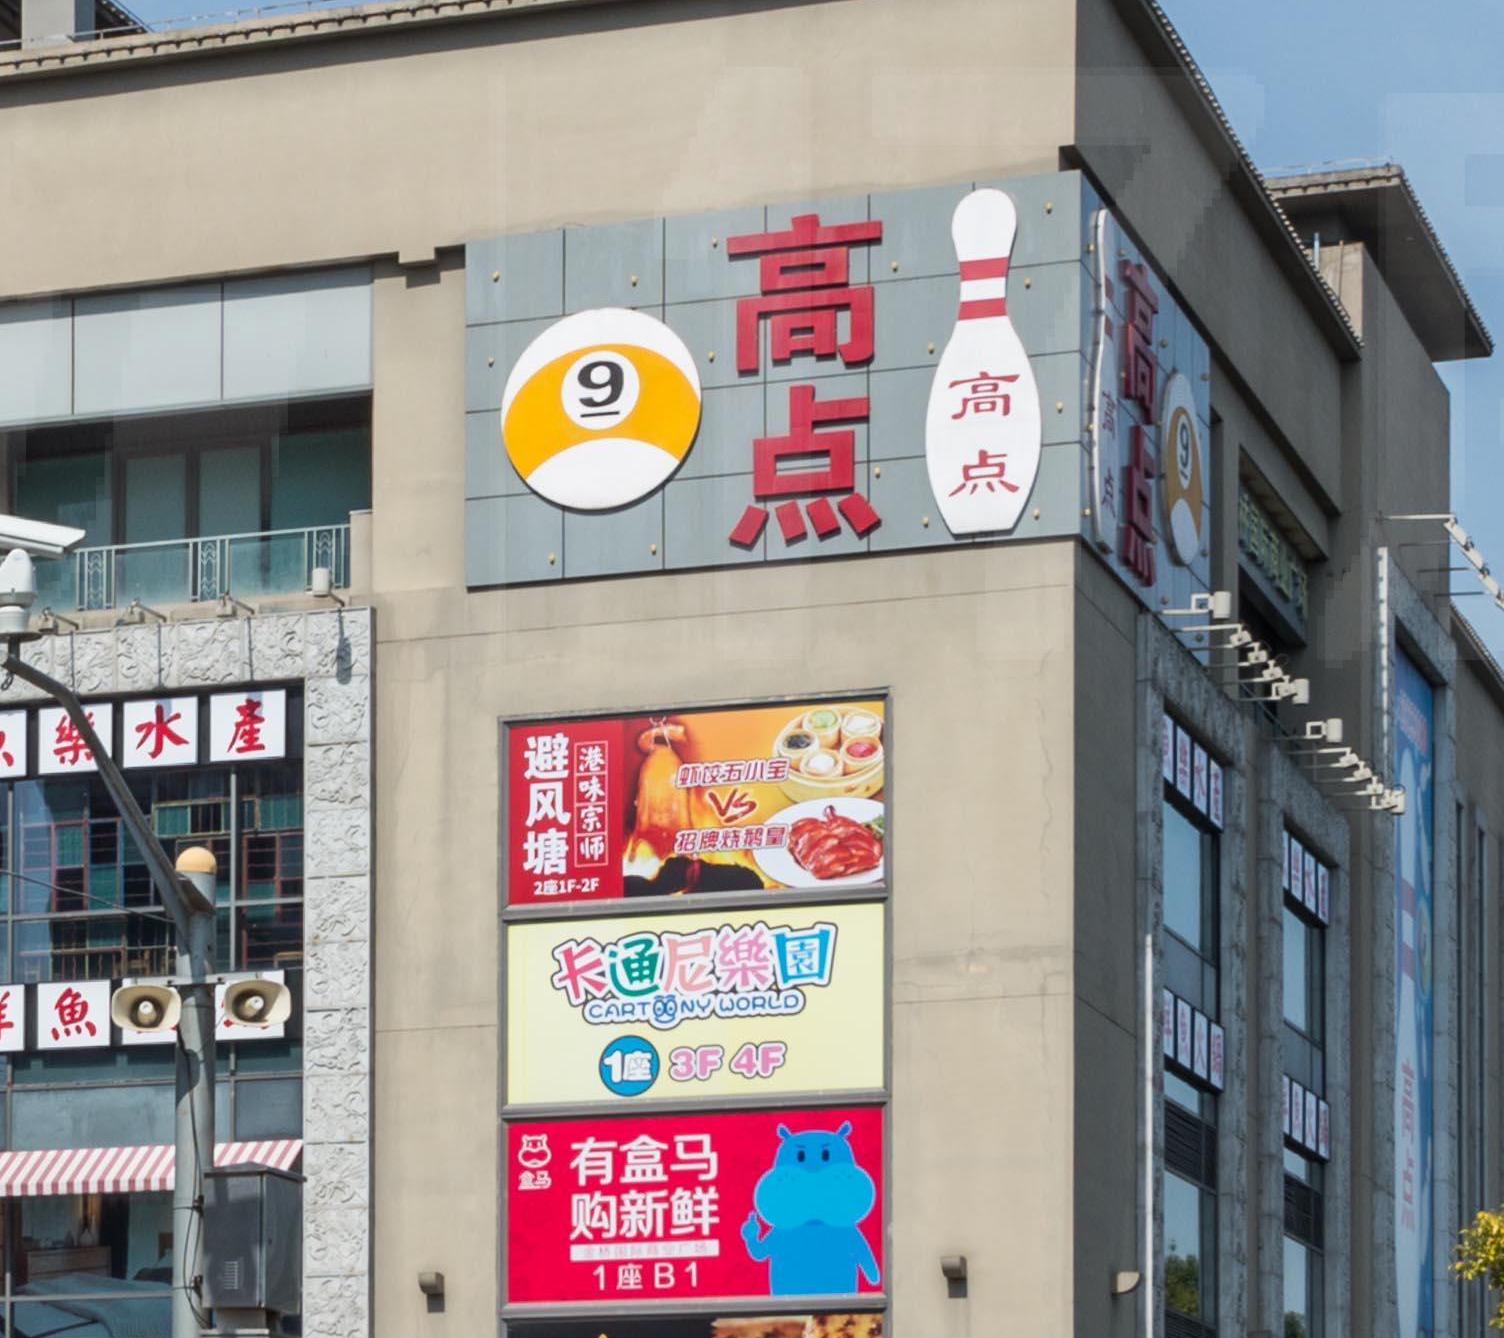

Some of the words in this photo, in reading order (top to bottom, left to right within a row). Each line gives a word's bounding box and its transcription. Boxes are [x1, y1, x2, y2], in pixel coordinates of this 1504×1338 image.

[576, 358, 626, 418] 9
[726, 213, 884, 548] 高点
[947, 370, 1022, 496] 高点
[1121, 258, 1160, 587] 高点
[578, 744, 605, 862] 港味宗师
[675, 757, 791, 789] 虾饺五小宝
[523, 732, 571, 876] 避风塘
[555, 924, 836, 1007] 卡通尼樂園
[718, 992, 800, 1013] WORLD
[603, 1049, 654, 1084] 1座
[670, 1046, 722, 1079] 3F
[728, 1042, 787, 1076] 4F
[518, 1170, 552, 1191] 盒马
[570, 1133, 719, 1187] 有盒马
[569, 1186, 720, 1241] 购新鲜
